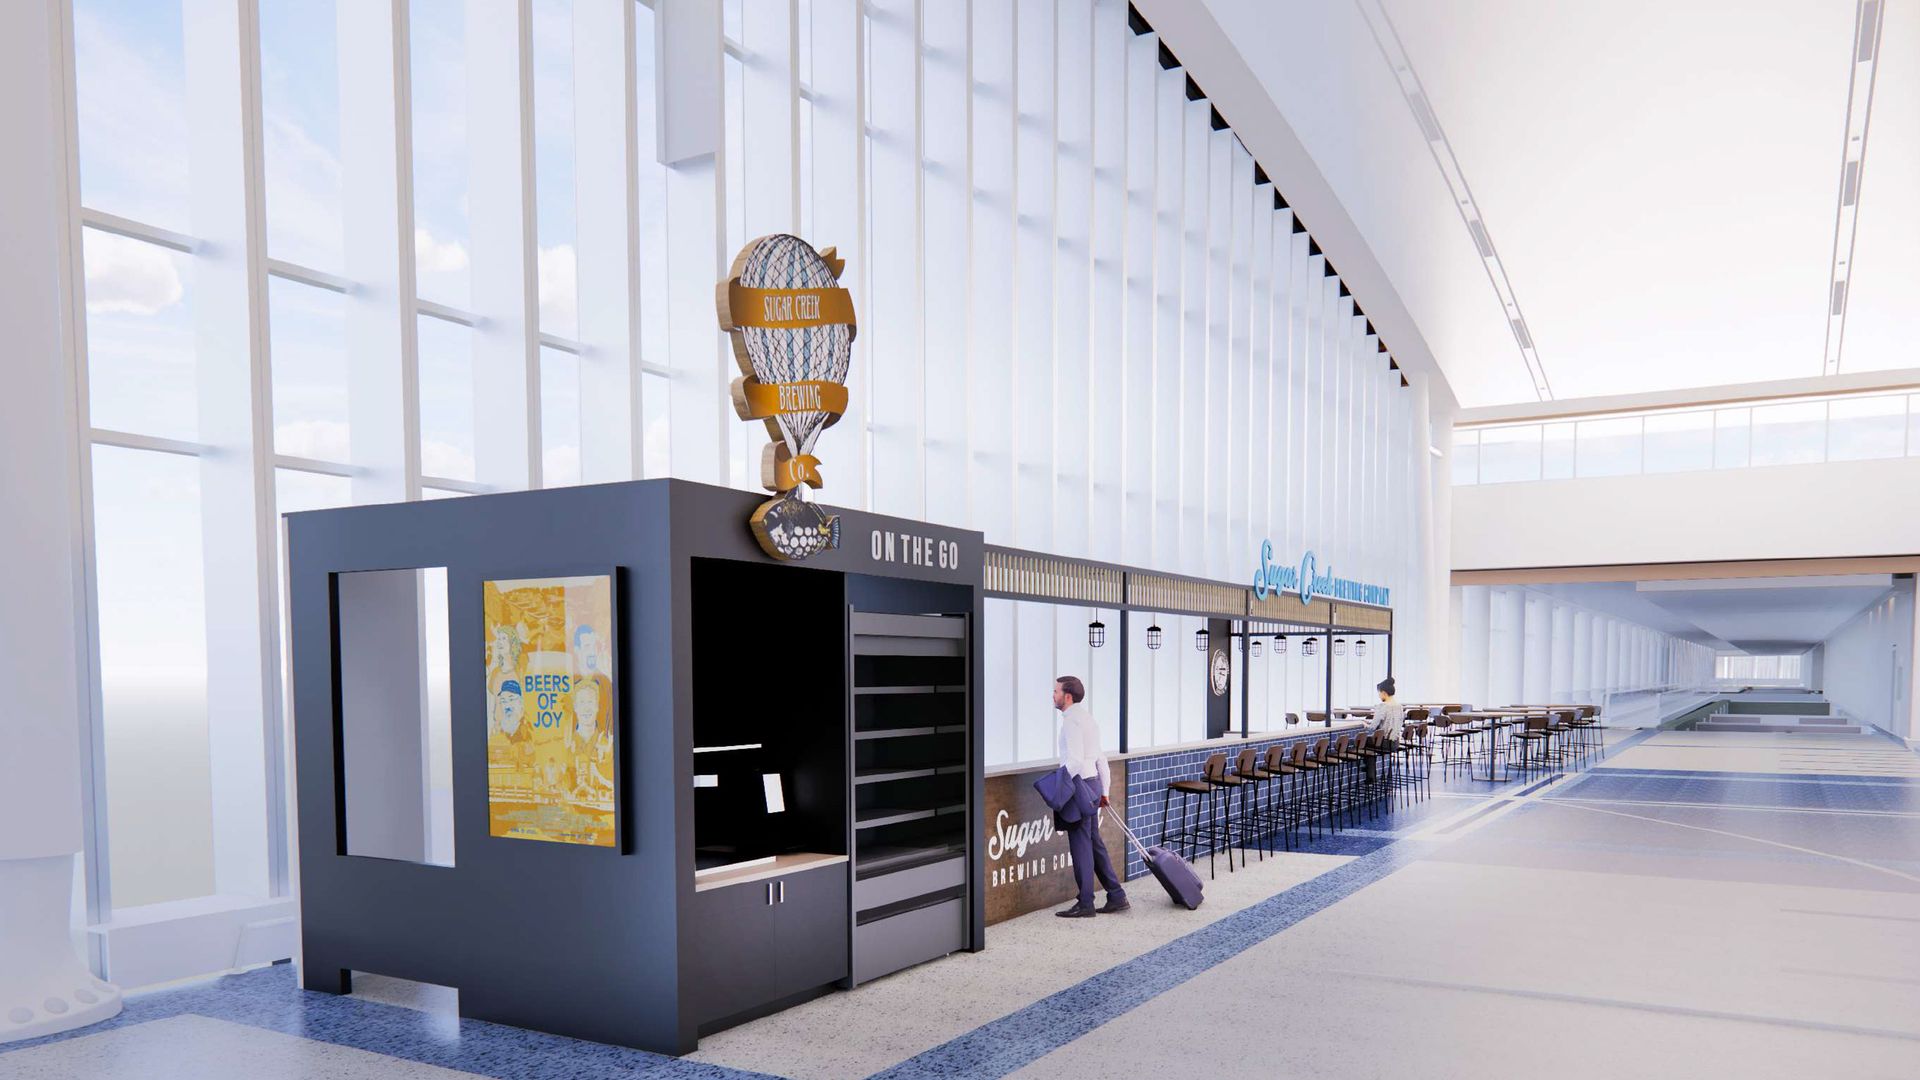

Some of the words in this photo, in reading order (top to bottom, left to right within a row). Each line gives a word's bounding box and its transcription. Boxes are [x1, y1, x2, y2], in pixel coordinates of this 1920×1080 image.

[763, 295, 794, 322] SUGAR
[795, 295, 821, 320] CREEK
[778, 384, 821, 411] BREWING
[871, 530, 895, 562] ON
[900, 534, 934, 567] THE
[938, 540, 959, 570] GO
[1254, 539, 1297, 601] Sugar
[525, 675, 570, 692] BEERS
[537, 693, 558, 711] OF
[534, 711, 562, 728] JOY
[988, 809, 1053, 860] Sugar
[992, 858, 1045, 887] BREWING
